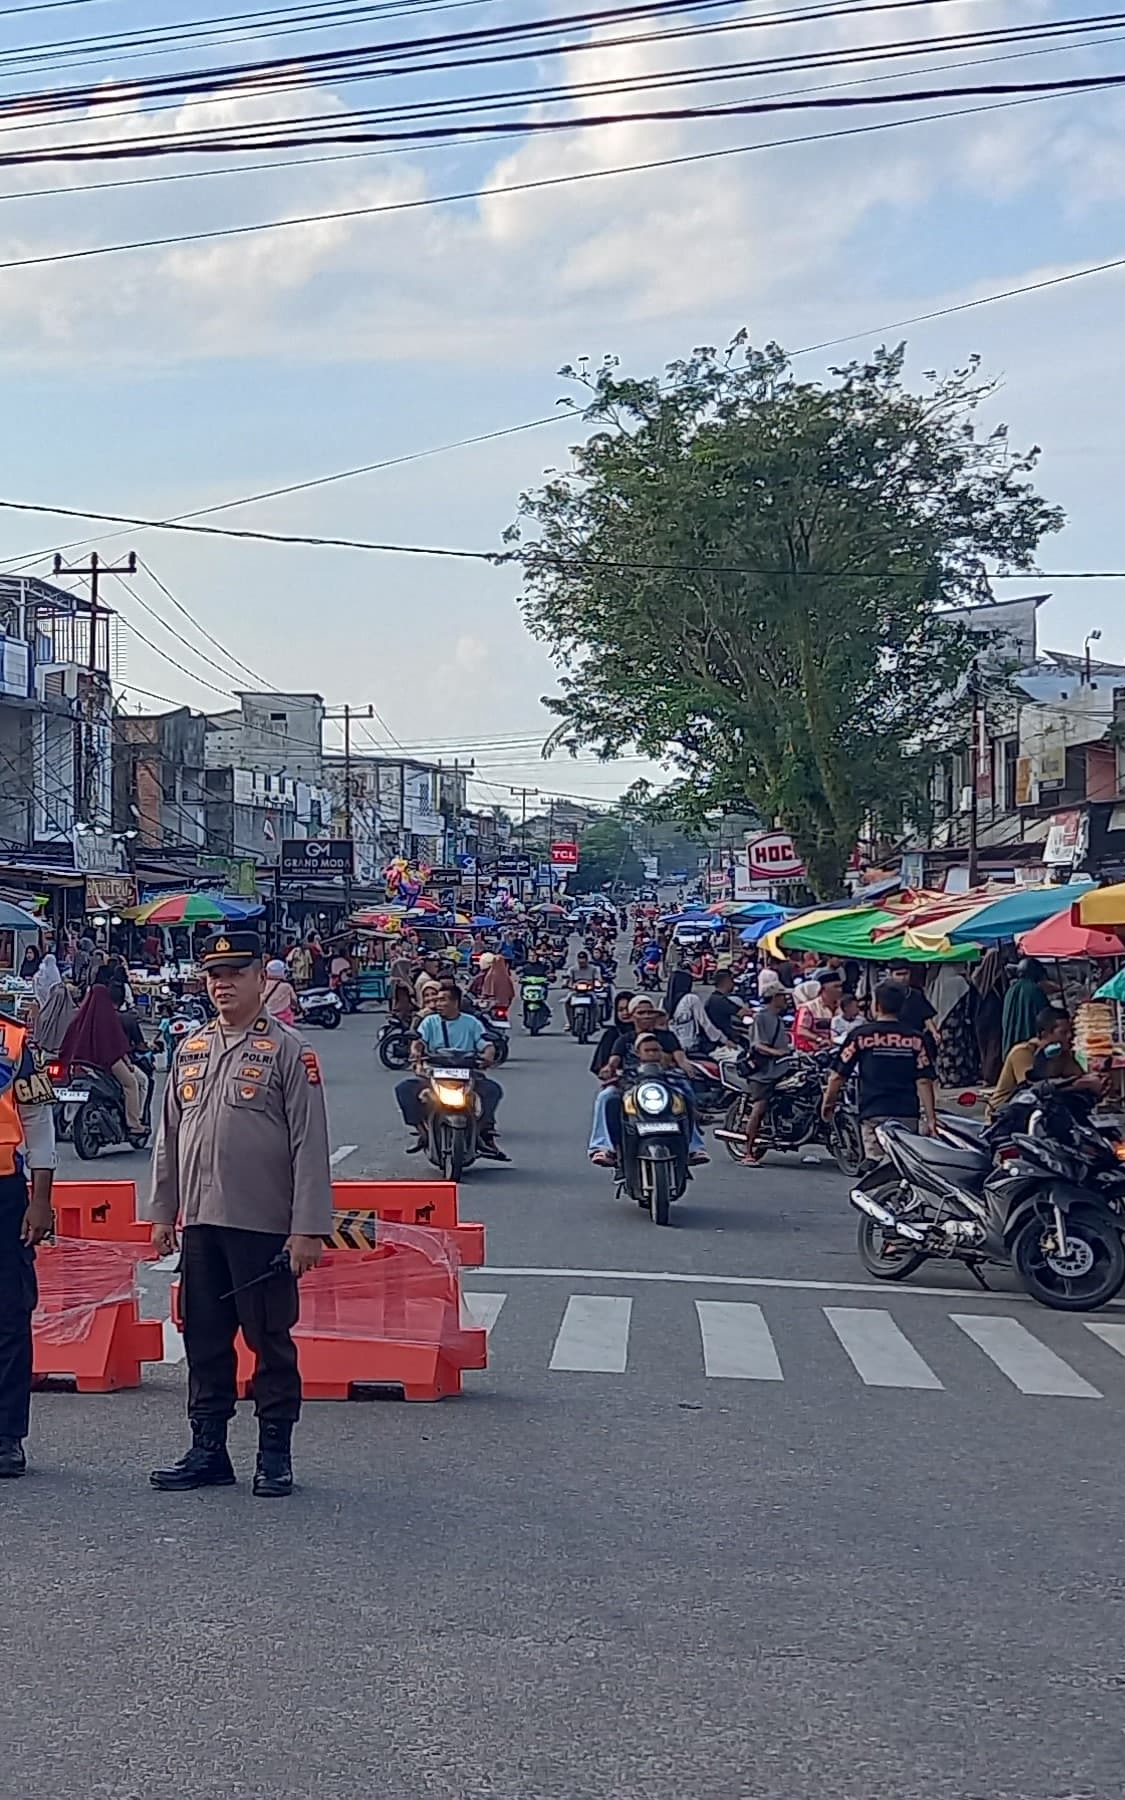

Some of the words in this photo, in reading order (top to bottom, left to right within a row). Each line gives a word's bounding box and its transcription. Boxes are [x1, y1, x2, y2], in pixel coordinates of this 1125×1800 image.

[552, 850, 576, 860] TCL
[755, 845, 801, 863] HOC
[284, 858, 319, 868] GRAND
[320, 858, 352, 869] MODA
[241, 1052, 274, 1065] POLRI
[15, 1072, 56, 1102] GAT
